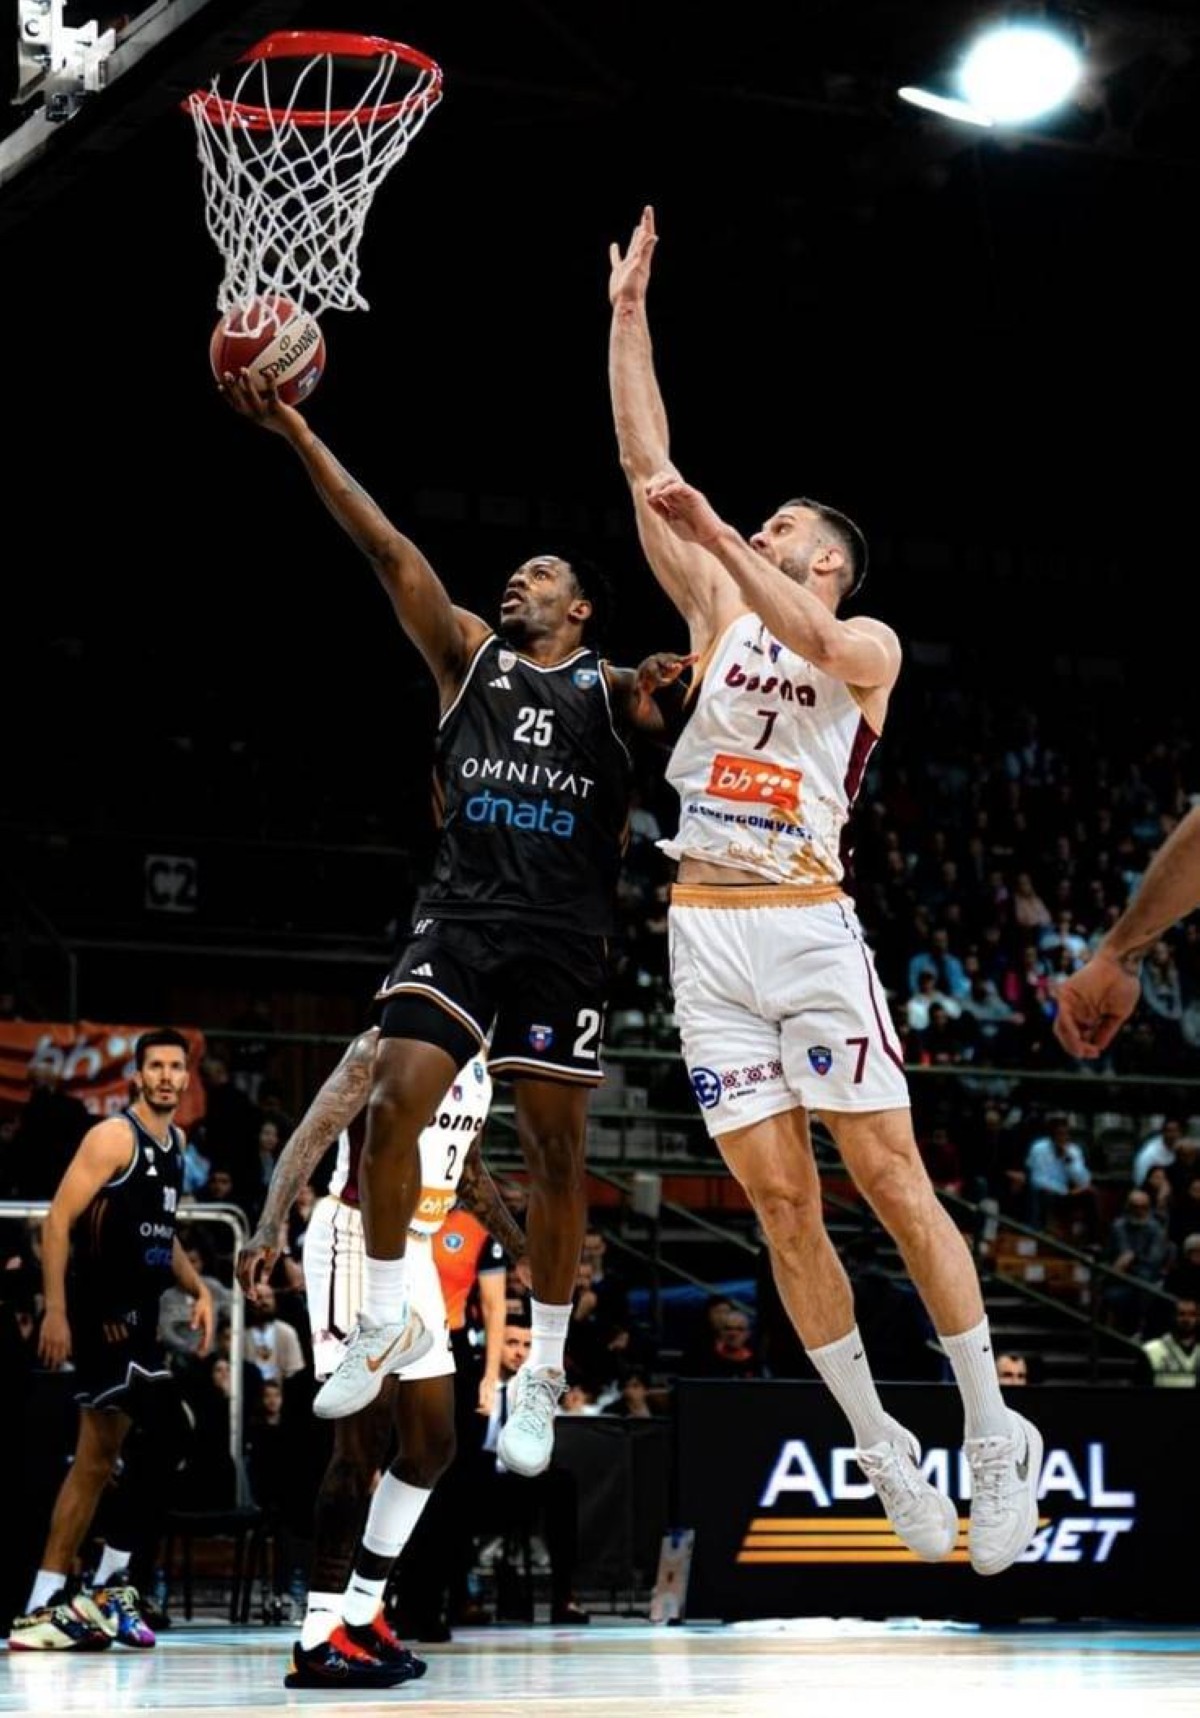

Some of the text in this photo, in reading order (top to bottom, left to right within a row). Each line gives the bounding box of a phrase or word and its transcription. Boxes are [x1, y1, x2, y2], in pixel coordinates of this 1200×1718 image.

[259, 323, 318, 378] SPALDING
[725, 664, 816, 707] bosna
[513, 706, 555, 748] 25
[754, 709, 777, 751] 7
[461, 757, 594, 799] OMNIYAT
[717, 768, 751, 791] bh
[465, 790, 575, 838] dnata
[573, 1008, 600, 1059] 2
[845, 1036, 869, 1084] 7
[444, 1144, 457, 1181] 2
[759, 1440, 1136, 1508] ADMIAL
